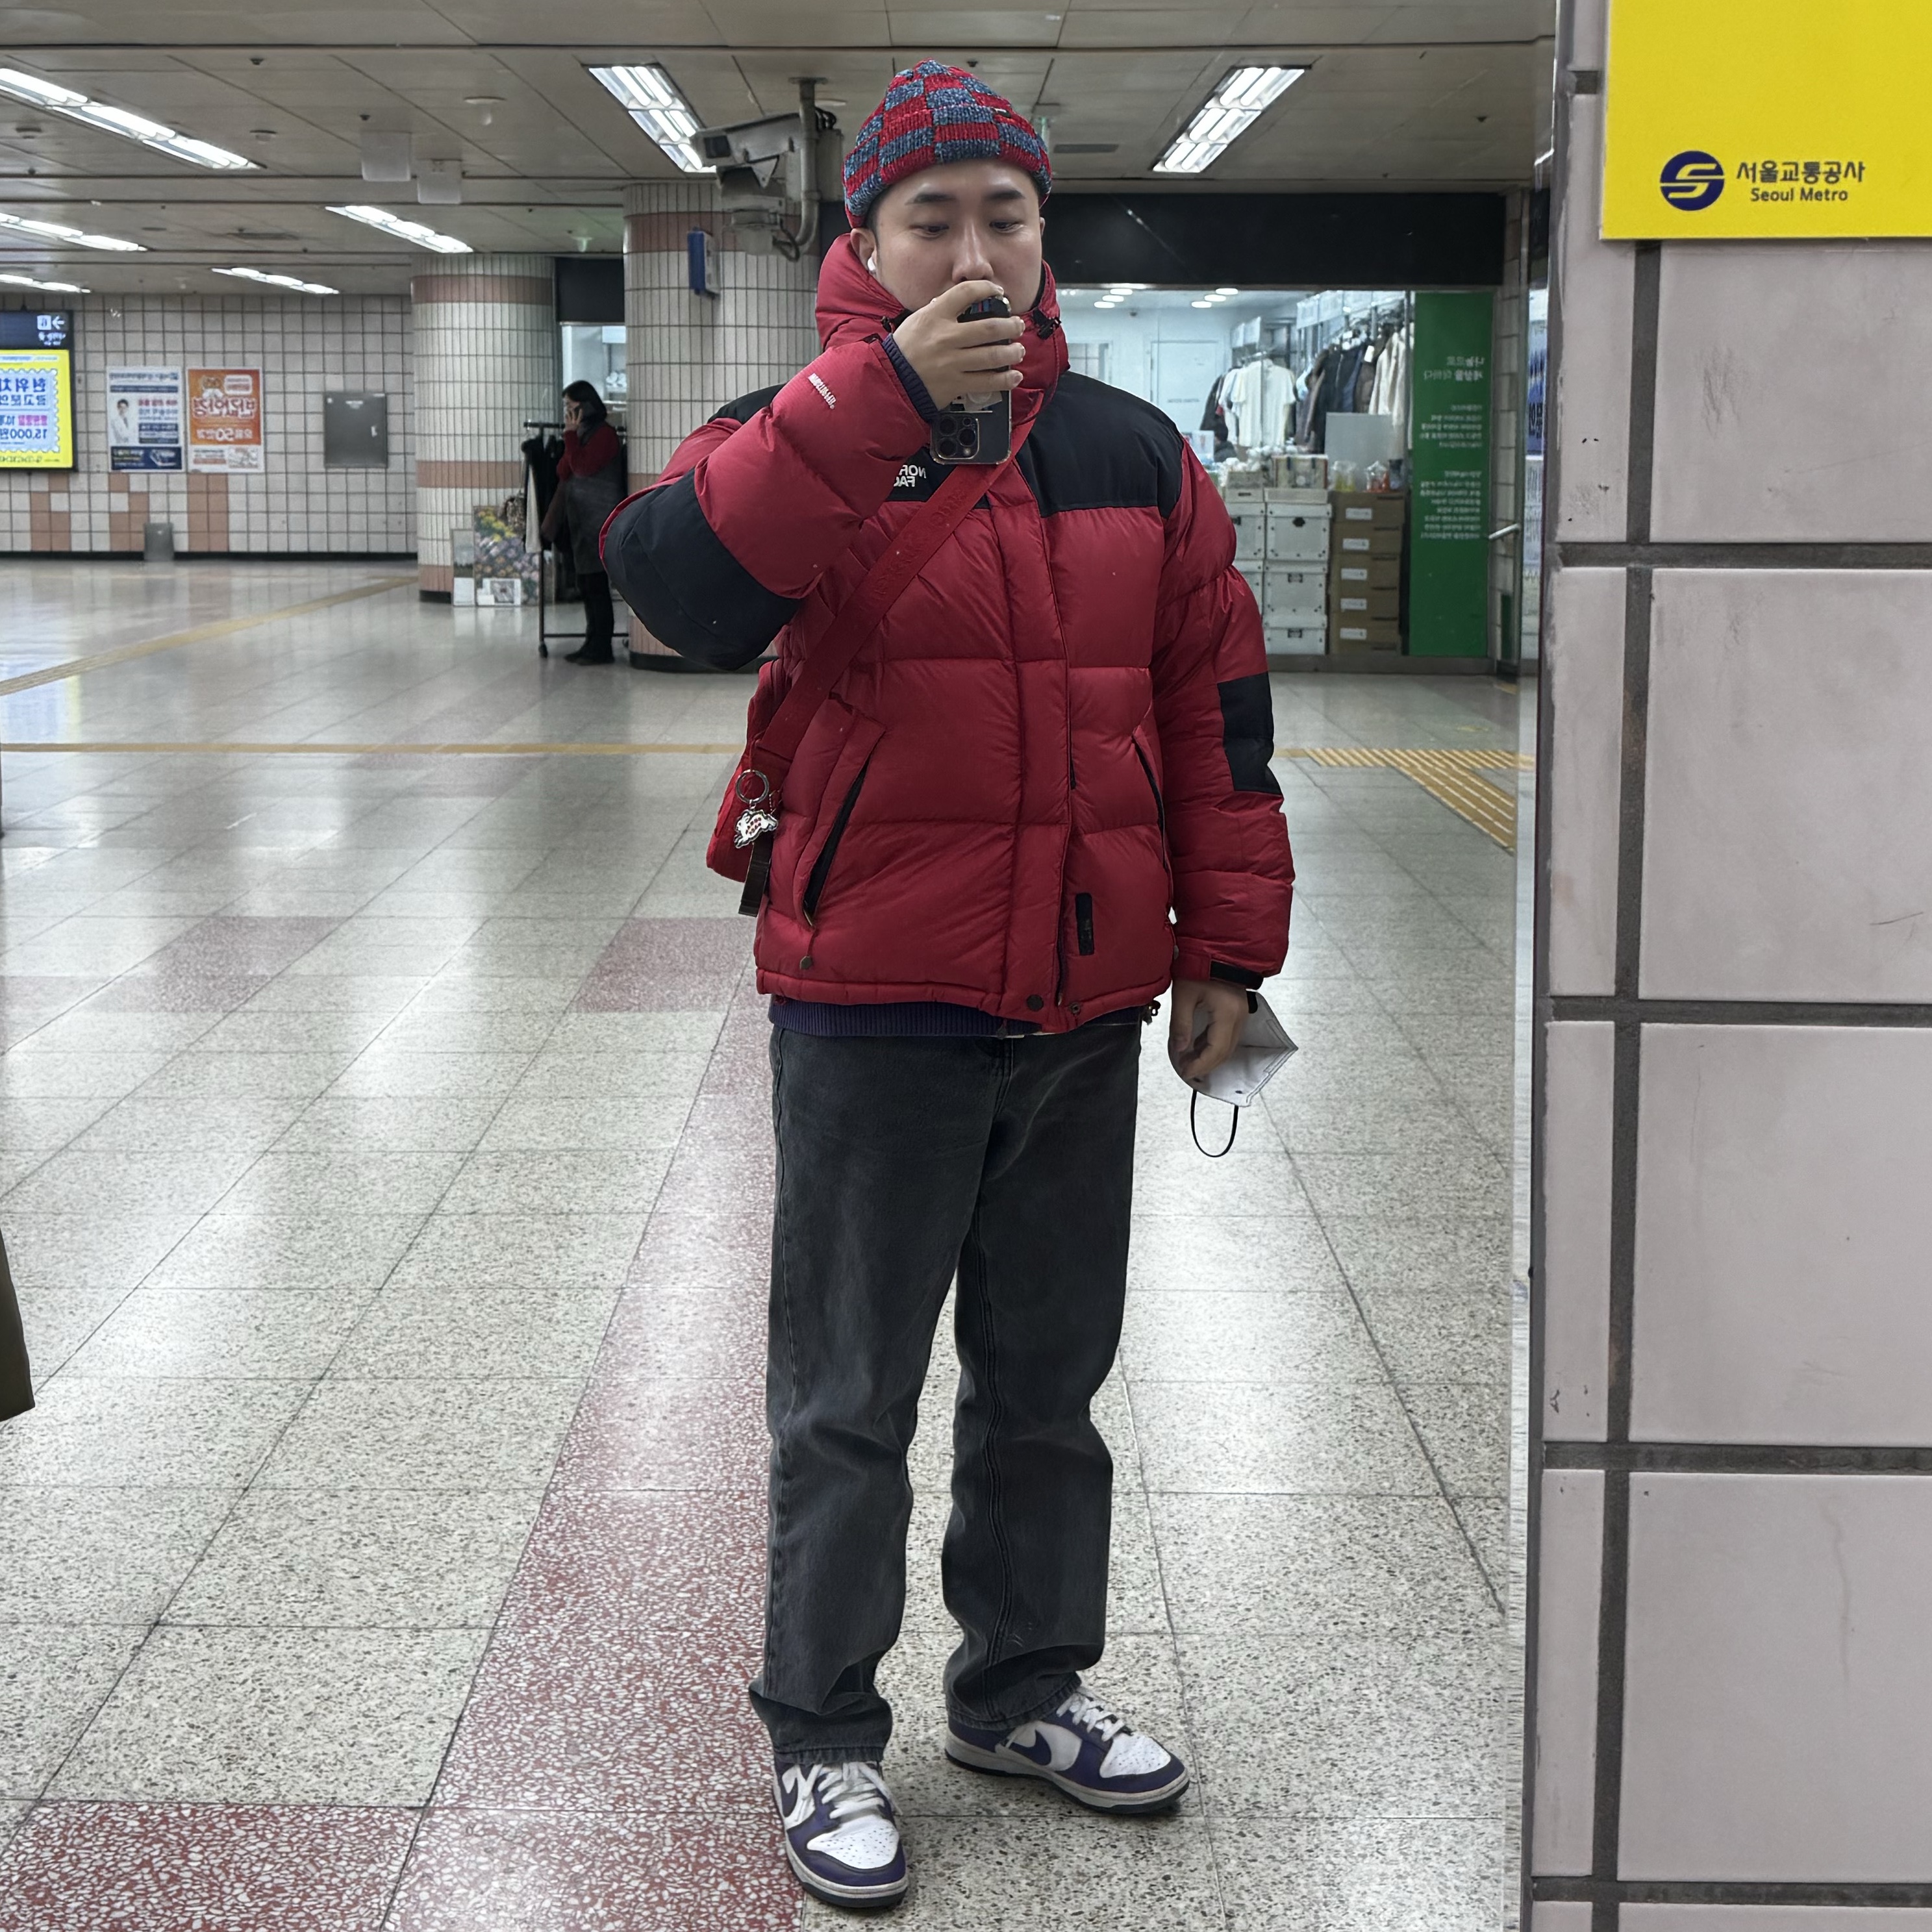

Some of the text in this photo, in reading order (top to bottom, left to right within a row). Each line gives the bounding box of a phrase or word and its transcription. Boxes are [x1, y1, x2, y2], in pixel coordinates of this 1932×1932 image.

[1736, 160, 1866, 184] 서울교통공사
[1750, 188, 1849, 202] Seoul Metro
